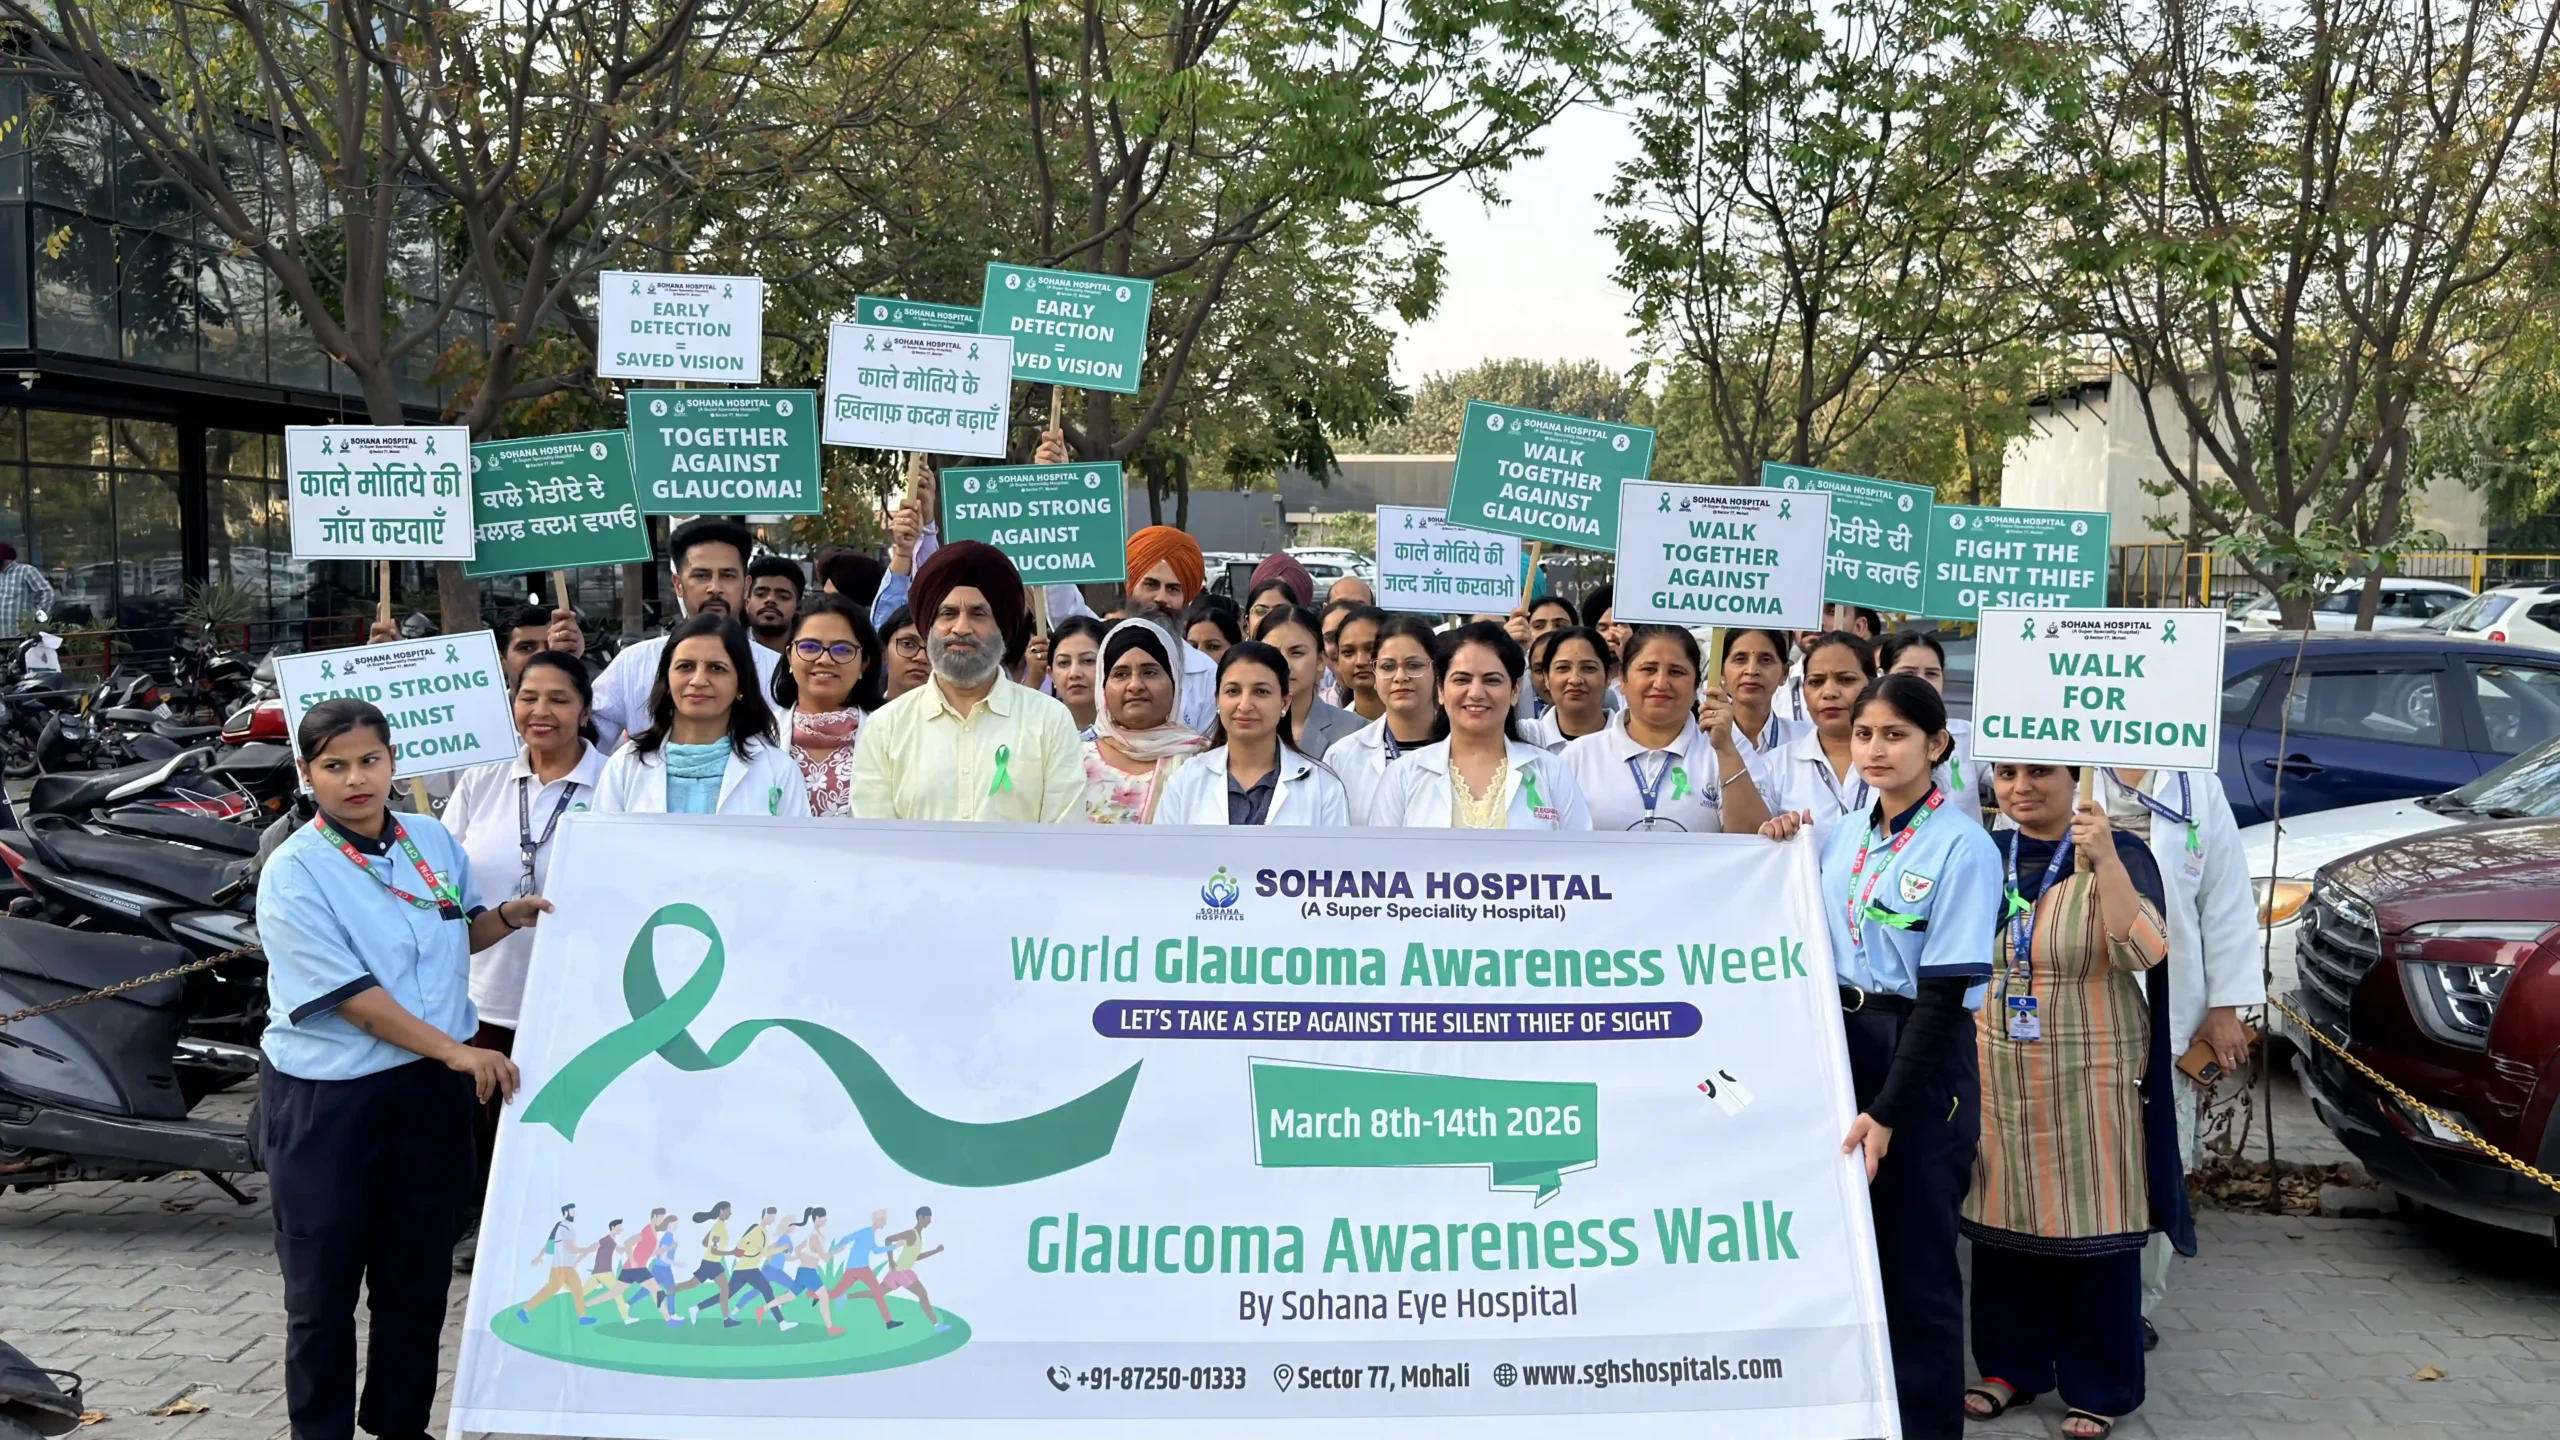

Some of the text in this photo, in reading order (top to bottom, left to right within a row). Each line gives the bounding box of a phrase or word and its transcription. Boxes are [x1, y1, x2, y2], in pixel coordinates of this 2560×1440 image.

[1038, 277, 1111, 291] SOHANA HOSPITAL
[654, 303, 709, 317] EARLY
[904, 308, 974, 322] SOHANA HOSPITAL
[1036, 299, 1095, 319] EARLY
[631, 320, 731, 336] DETECTION
[1011, 317, 1114, 342] DETECTION
[894, 338, 961, 349] SOHANA HOSPITAL
[1055, 344, 1065, 352] =
[616, 352, 743, 370] SAVED VISION
[1012, 352, 1122, 378] VED VISION
[858, 364, 980, 395] काले मोतिये के
[834, 394, 1000, 433] ख़िलाफ़ कदम बढ़ाएँ
[659, 428, 789, 446] TOGETHER
[1524, 419, 1561, 432] SOHANA
[1564, 426, 1607, 439] HOSPITAL
[500, 444, 584, 459] SOHANA HOSPITAL
[671, 454, 780, 472] AGAINST
[1524, 442, 1585, 466] WALK
[298, 462, 461, 497] काले मोतिये की
[999, 473, 1078, 483] SOHANA HOSPITAL
[1498, 460, 1602, 491] TOGETHER
[480, 474, 605, 508] ਕਾਲੇ ਮੋਤੀਏ ਦੇ
[652, 480, 802, 498] GLAUCOMA!
[1499, 483, 1592, 512] AGAINST
[1817, 480, 1851, 492] SOHANA
[1854, 487, 1893, 499] HOSPITAL
[956, 498, 1111, 519] STAND STRONG
[1693, 496, 1770, 507] SOHANA HOSPITAL
[319, 506, 447, 544] जाँच करवाएँ
[529, 515, 577, 535] ਕਦਮ
[580, 503, 636, 532] ਵਧਾਓ
[1483, 502, 1600, 535] GLAUCOMA
[1985, 516, 2066, 526] SOHANA HOSPITAL
[991, 527, 1079, 545] AGAINST
[1689, 521, 1757, 541] WALK
[1887, 524, 1912, 552] ਦੀ
[1008, 553, 1095, 571] AUCOMA
[1394, 538, 1504, 565] काले मोतिये की
[1663, 543, 1779, 566] TOGETHER
[1955, 539, 2079, 562] FIGHT THE
[1383, 568, 1515, 597] जल्द जाँच करवाओ
[1668, 568, 1770, 590] AGAINST
[1866, 561, 1921, 589] ਕਰਾਓ
[1937, 563, 2094, 588] SILENT THIEF
[1652, 591, 1783, 615] GLAUCOMA
[1958, 589, 2070, 608] OF SIGHT
[2104, 621, 2151, 629] HOSPITAL
[355, 648, 435, 664] SOHANA HOSPITAL
[2049, 653, 2146, 678] WALK
[389, 670, 489, 698] STRONG
[2064, 686, 2126, 710] FOR
[388, 705, 455, 729] AINST
[1983, 715, 2206, 747] CLEAR VISION
[395, 733, 480, 760] UCOMA
[1914, 810, 1929, 826] CFM
[323, 828, 340, 844] CFM
[1896, 831, 1911, 848] CFM
[345, 847, 362, 863] CFM
[403, 841, 418, 858] CFM
[420, 865, 434, 882] CFM
[1255, 869, 1612, 900] SOHANA HOSPITAL
[1301, 902, 1566, 922] (A Super Speciality Hospital)
[1011, 935, 1808, 987] World Glaucoma Awareness Week
[1177, 1010, 1228, 1032] TAKE
[1233, 1011, 1247, 1031] A
[1252, 1011, 1301, 1032] STEP
[1307, 1012, 1393, 1033] AGAINST
[1399, 1012, 1436, 1033] THE
[1443, 1012, 1511, 1034] SILENT
[1517, 1012, 1574, 1033] THIEF
[1580, 1011, 1605, 1032] OF
[1611, 1010, 1672, 1032] SIGHT
[1270, 1106, 1582, 1139] March 8th-14th 2026
[1027, 1200, 1799, 1274] Glaucoma Awareness Walk
[1240, 1284, 1577, 1326] By Sohana Eye Hospital
[1077, 1366, 1246, 1390] +91-87250-01333
[1298, 1363, 1470, 1392] Sector 77, Mohali
[1523, 1356, 1783, 1388] www.sghshospitals.com
